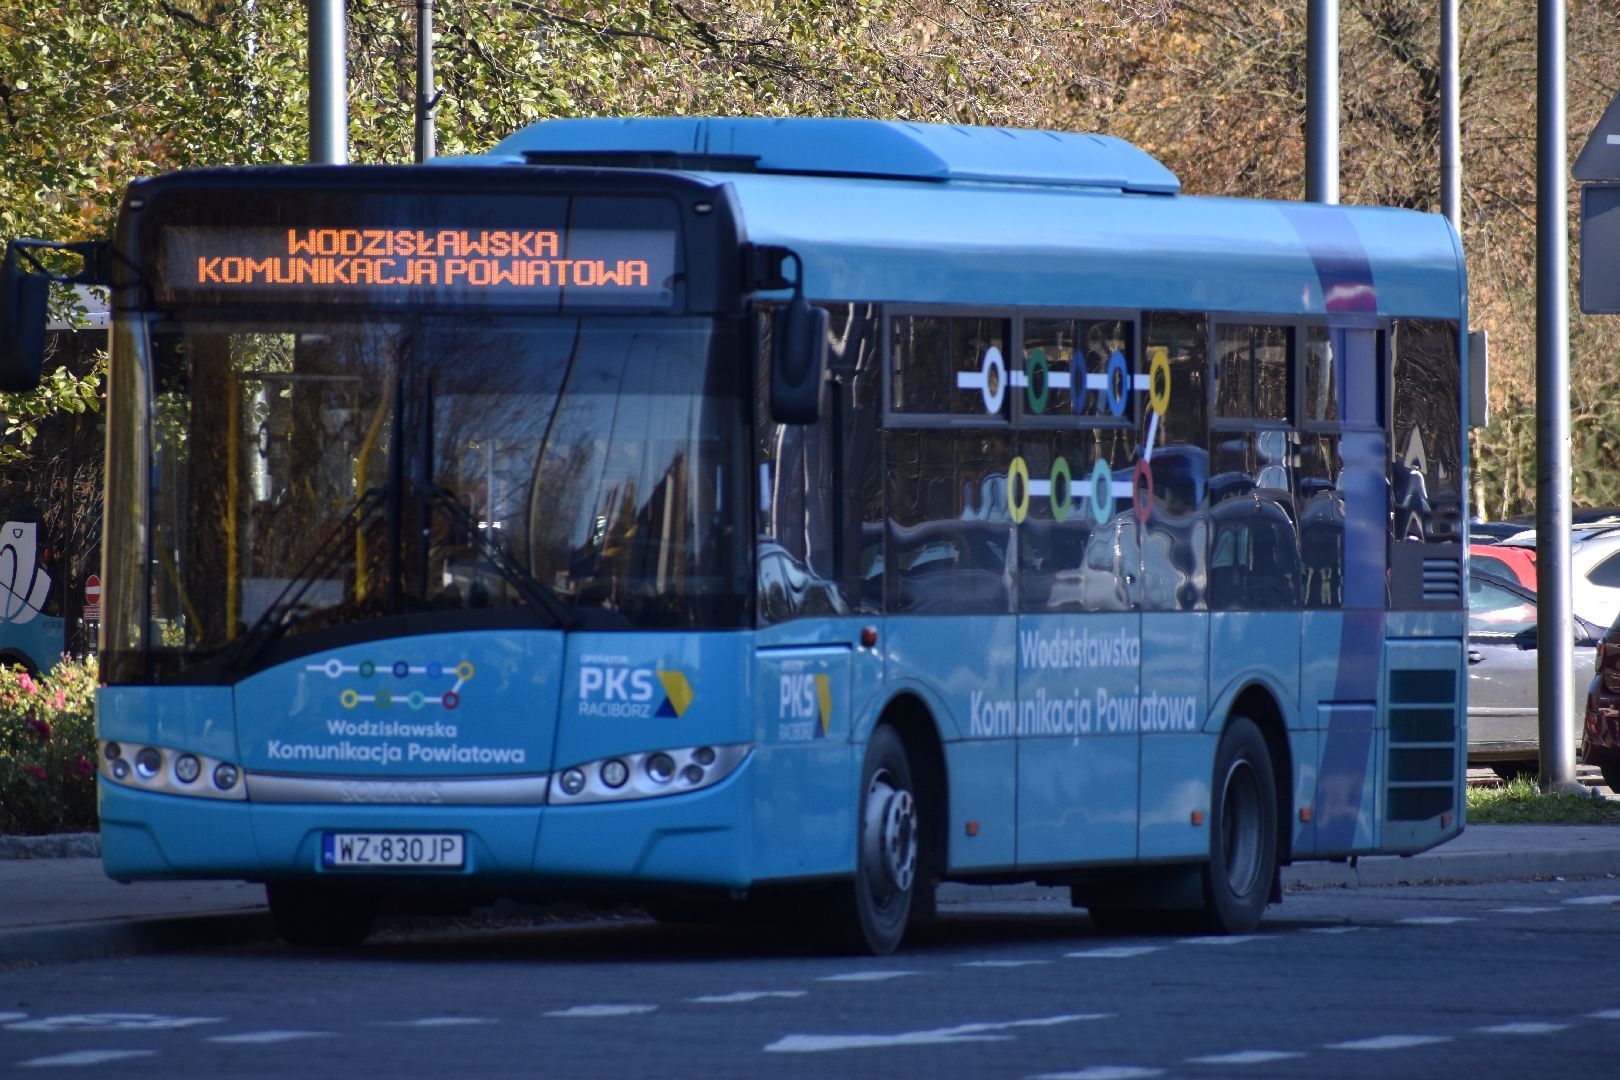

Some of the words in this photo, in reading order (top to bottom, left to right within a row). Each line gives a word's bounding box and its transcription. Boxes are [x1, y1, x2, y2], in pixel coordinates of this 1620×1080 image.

[288, 229, 558, 257] WODZISŁAWSKA
[198, 256, 438, 284] KOMUNIKACJA
[445, 259, 648, 286] POWIATOWA
[1020, 627, 1141, 669] Wodzisławska
[579, 666, 654, 701] PKS
[779, 673, 815, 718] PKS
[327, 719, 458, 738] Wodzisławska
[969, 687, 1091, 746] Komunikacja
[1096, 685, 1197, 731] Powiatowa
[267, 740, 402, 765] Komunikacja
[407, 743, 526, 764] Powiatowa
[340, 837, 371, 862] WZ
